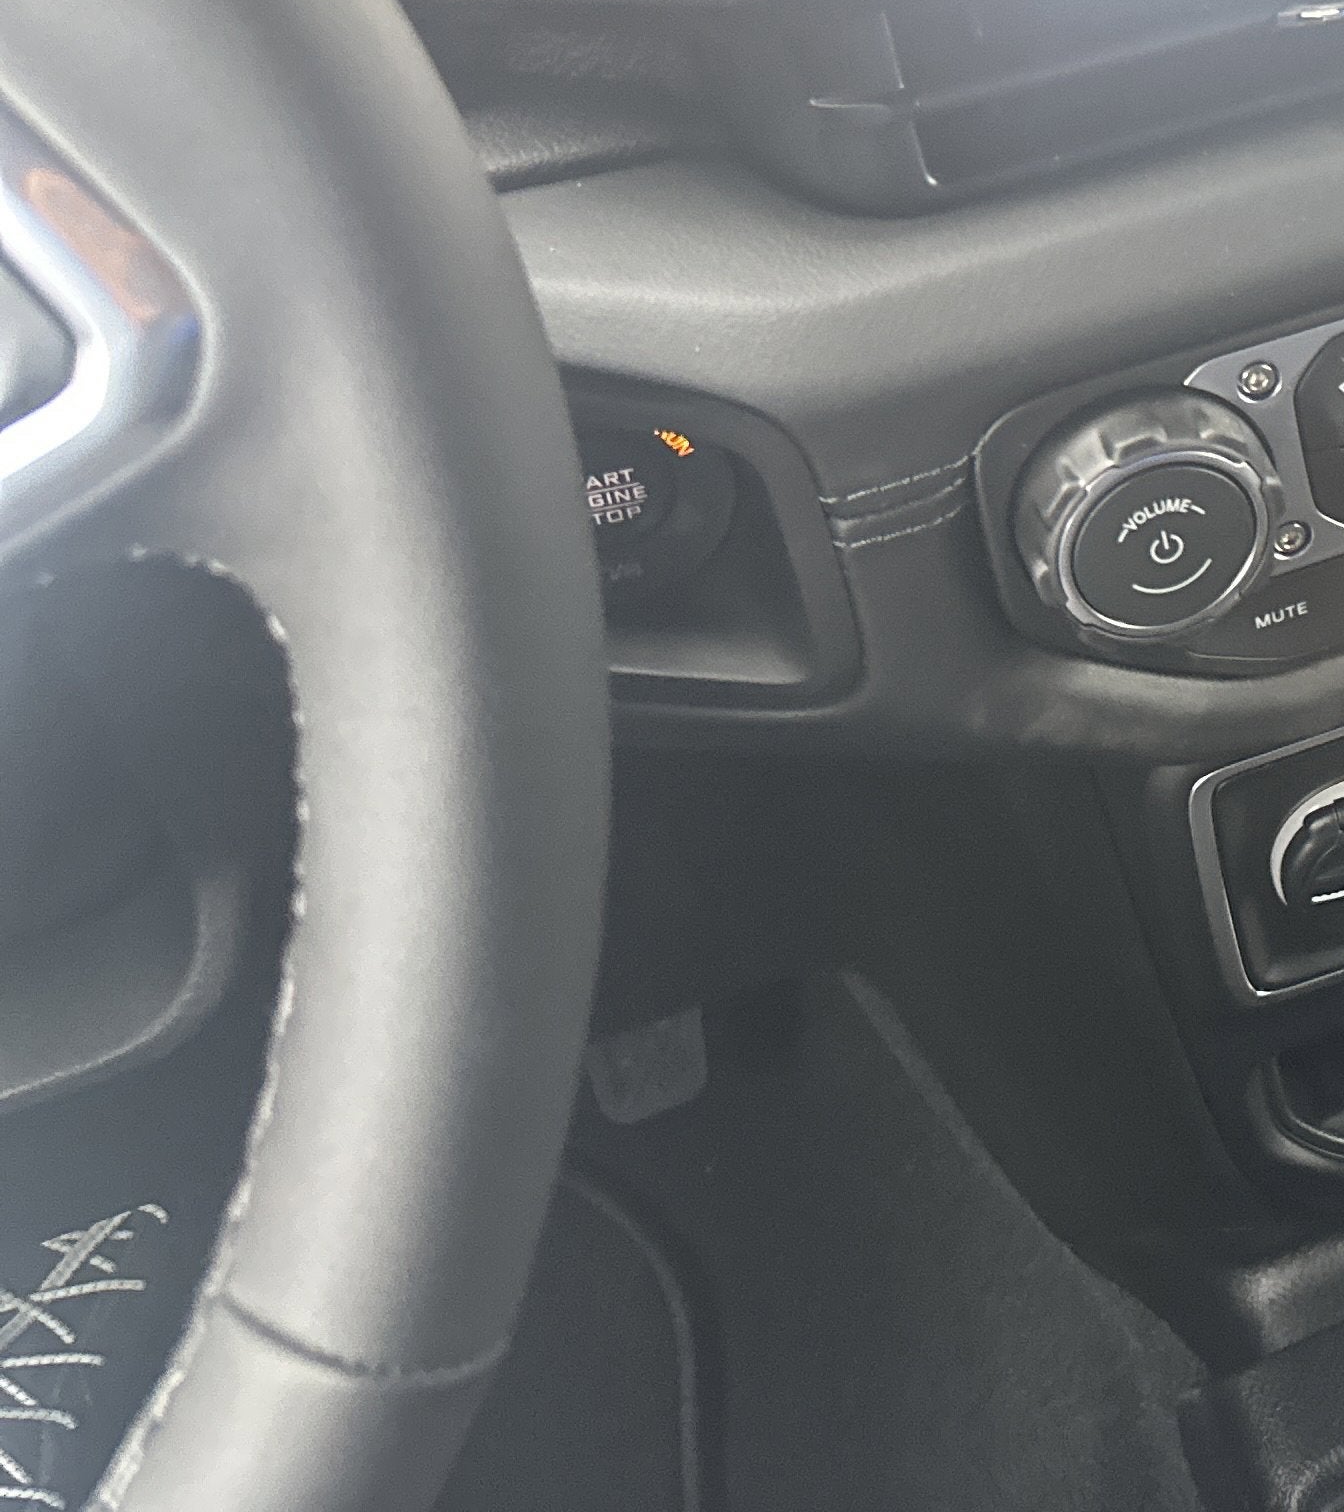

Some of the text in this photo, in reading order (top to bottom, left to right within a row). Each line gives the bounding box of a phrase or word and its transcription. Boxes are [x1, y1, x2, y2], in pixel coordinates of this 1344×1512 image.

[586, 467, 634, 490] ART
[588, 485, 648, 509] GINE
[591, 506, 642, 526] TOP
[1122, 498, 1192, 534] VOLUME
[1255, 601, 1308, 629] MUTE
